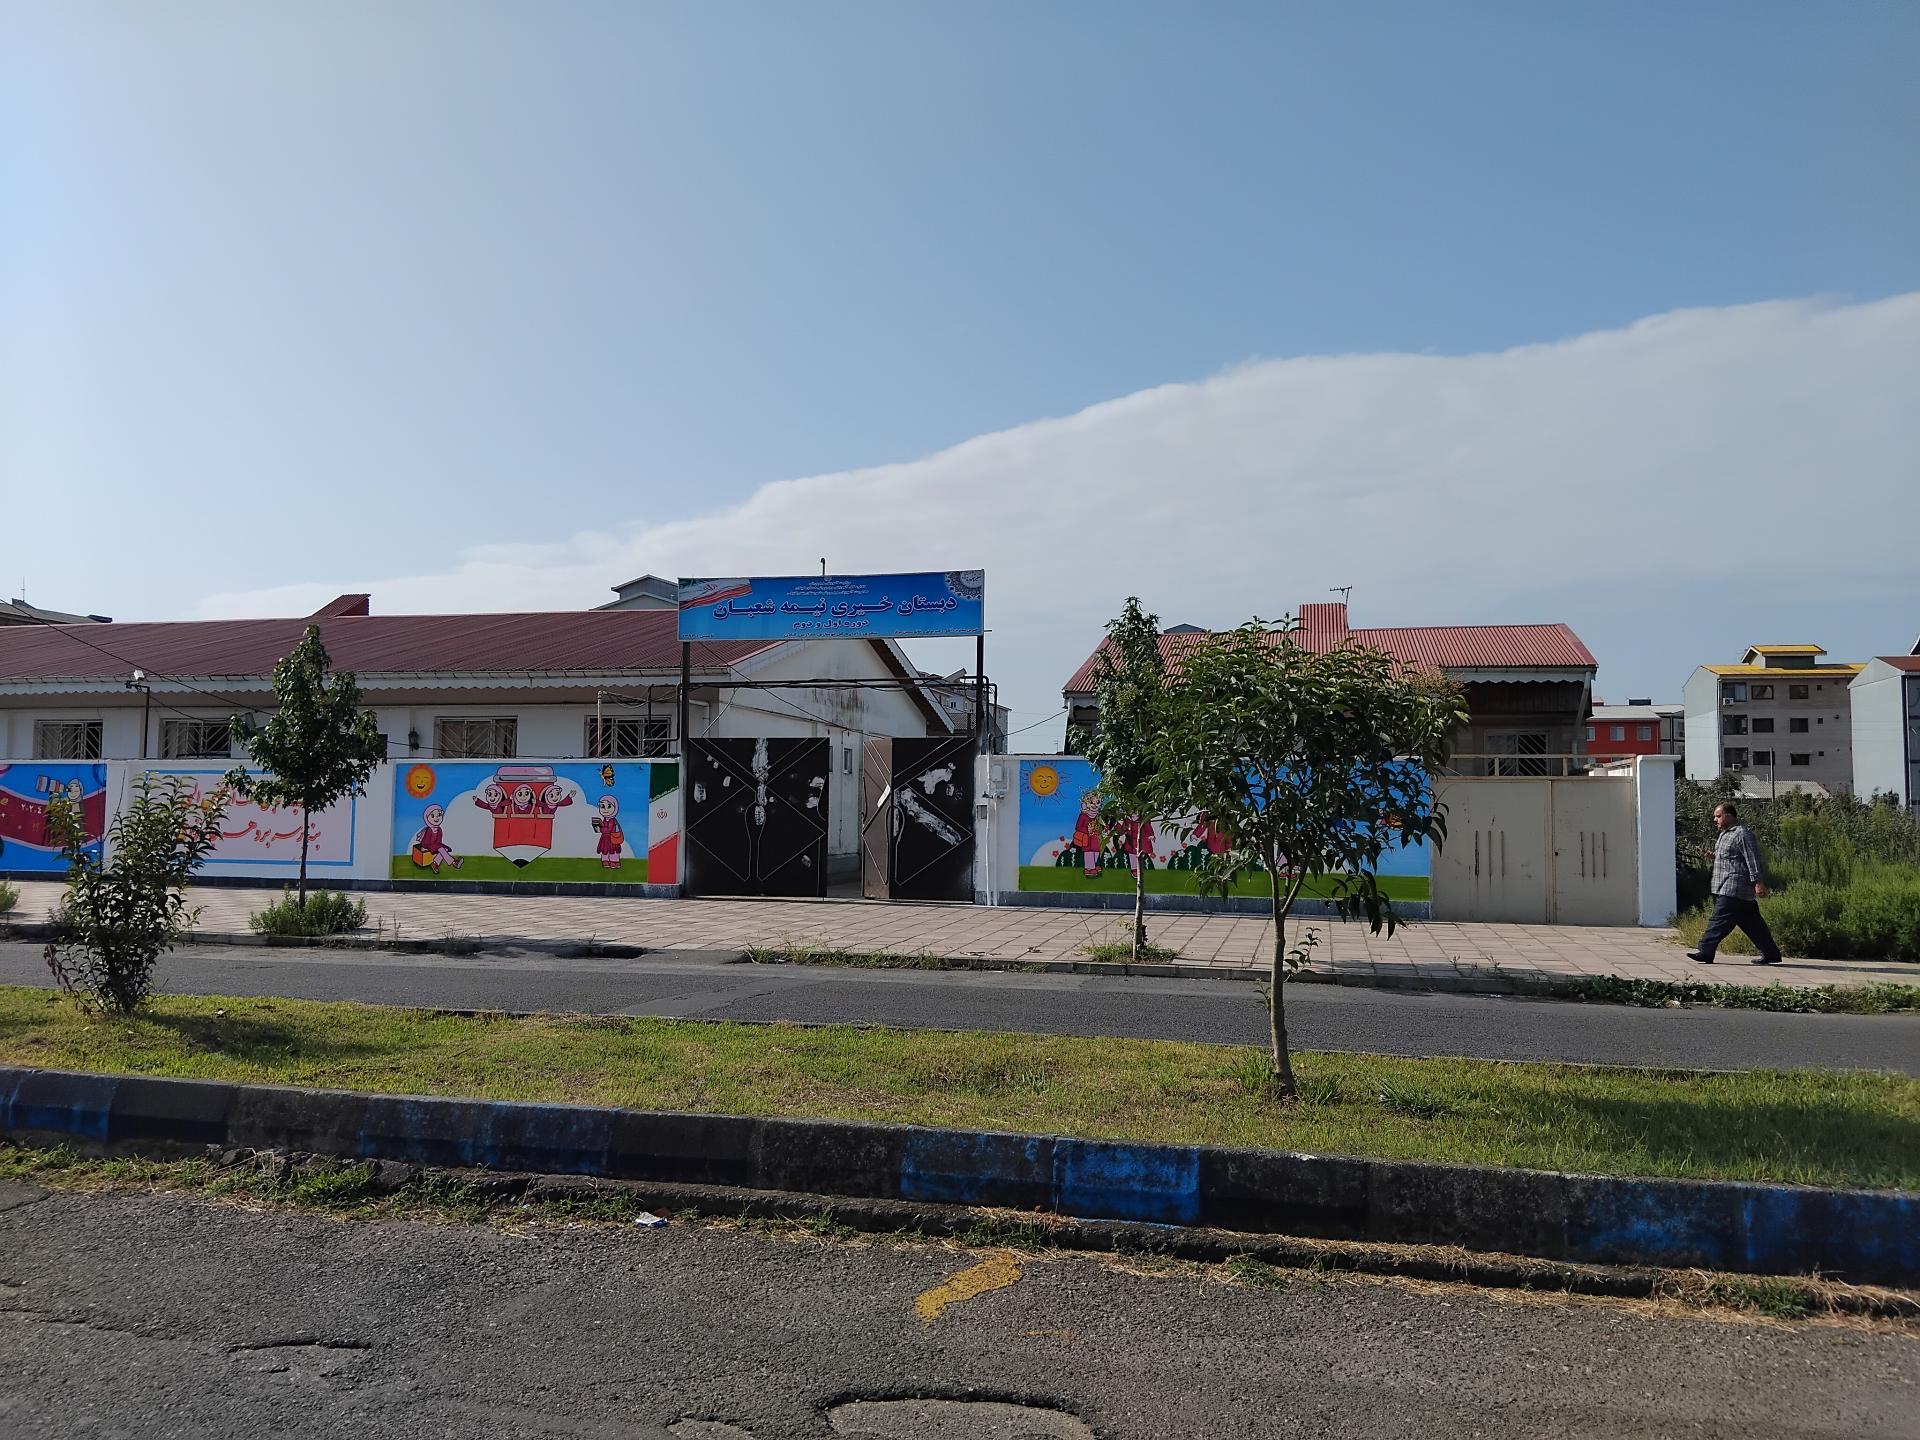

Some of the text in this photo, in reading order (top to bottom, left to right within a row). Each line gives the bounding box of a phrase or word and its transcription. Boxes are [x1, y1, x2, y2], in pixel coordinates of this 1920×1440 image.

[712, 594, 957, 620] دبستان خیری نیمه شعبان
[792, 618, 869, 630] دوره اول و دوم
